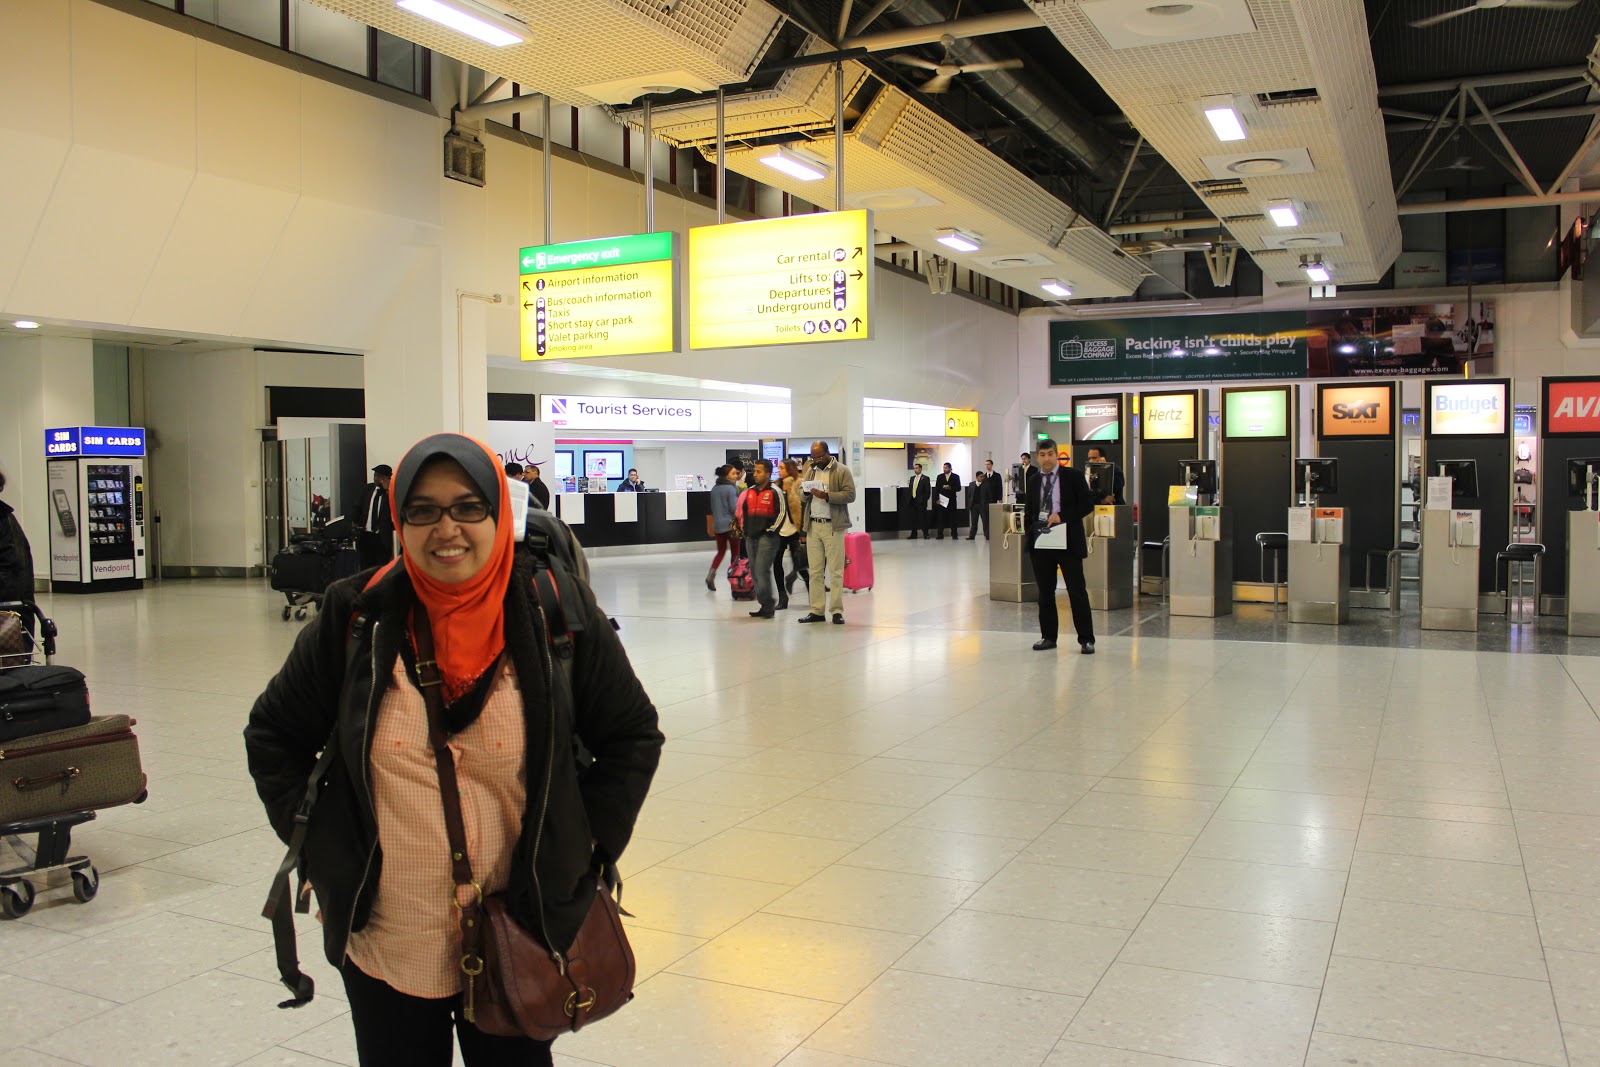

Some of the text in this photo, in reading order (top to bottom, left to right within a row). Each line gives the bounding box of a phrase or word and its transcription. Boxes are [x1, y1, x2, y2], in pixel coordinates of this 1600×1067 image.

[547, 248, 621, 265] Emergency exit
[777, 250, 831, 264] Car rental
[547, 272, 639, 288] Airport information
[790, 273, 831, 284] Lifts to:
[547, 289, 652, 306] Bus/coach information
[769, 287, 831, 300] Departures
[547, 308, 571, 318] Taxis
[757, 299, 831, 314] Underground
[547, 315, 634, 330] Short stay car park
[776, 325, 801, 333] Toilets
[548, 329, 609, 342] Valet parking
[1125, 337, 1181, 352] Packing
[1220, 333, 1261, 347] childs
[1266, 332, 1296, 348] play
[1271, 347, 1296, 355] Wrapping
[1354, 366, 1449, 375] www.excess-baggage.com
[577, 402, 692, 417] Tourist Services
[1436, 395, 1498, 414] Budget
[1148, 408, 1183, 421] Hertz
[957, 418, 975, 428] Taxis
[54, 431, 70, 441] SIM
[84, 436, 141, 446] SIM CARDS
[48, 442, 77, 453] CARDS
[94, 564, 131, 573] Vendpoint
